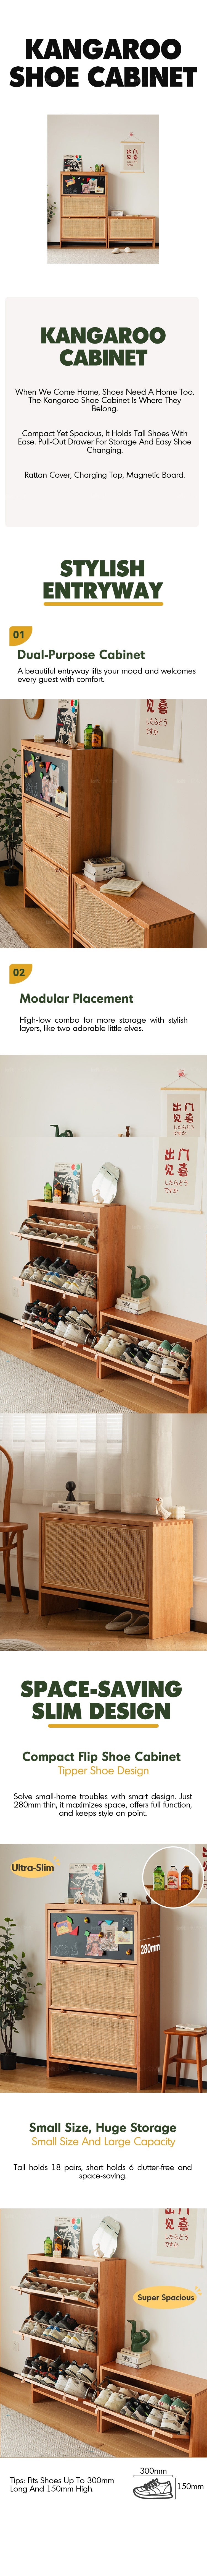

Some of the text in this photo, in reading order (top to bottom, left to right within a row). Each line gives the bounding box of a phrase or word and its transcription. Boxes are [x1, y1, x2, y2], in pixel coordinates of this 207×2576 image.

[147, 699, 168, 714] 见喜
[146, 718, 167, 726] したらどう
[173, 1103, 194, 1111] 出门
[173, 1113, 194, 1123] 见喜
[165, 1148, 189, 1161] 出门
[165, 1163, 187, 1177] 见喜
[166, 2217, 188, 2231] 见喜
